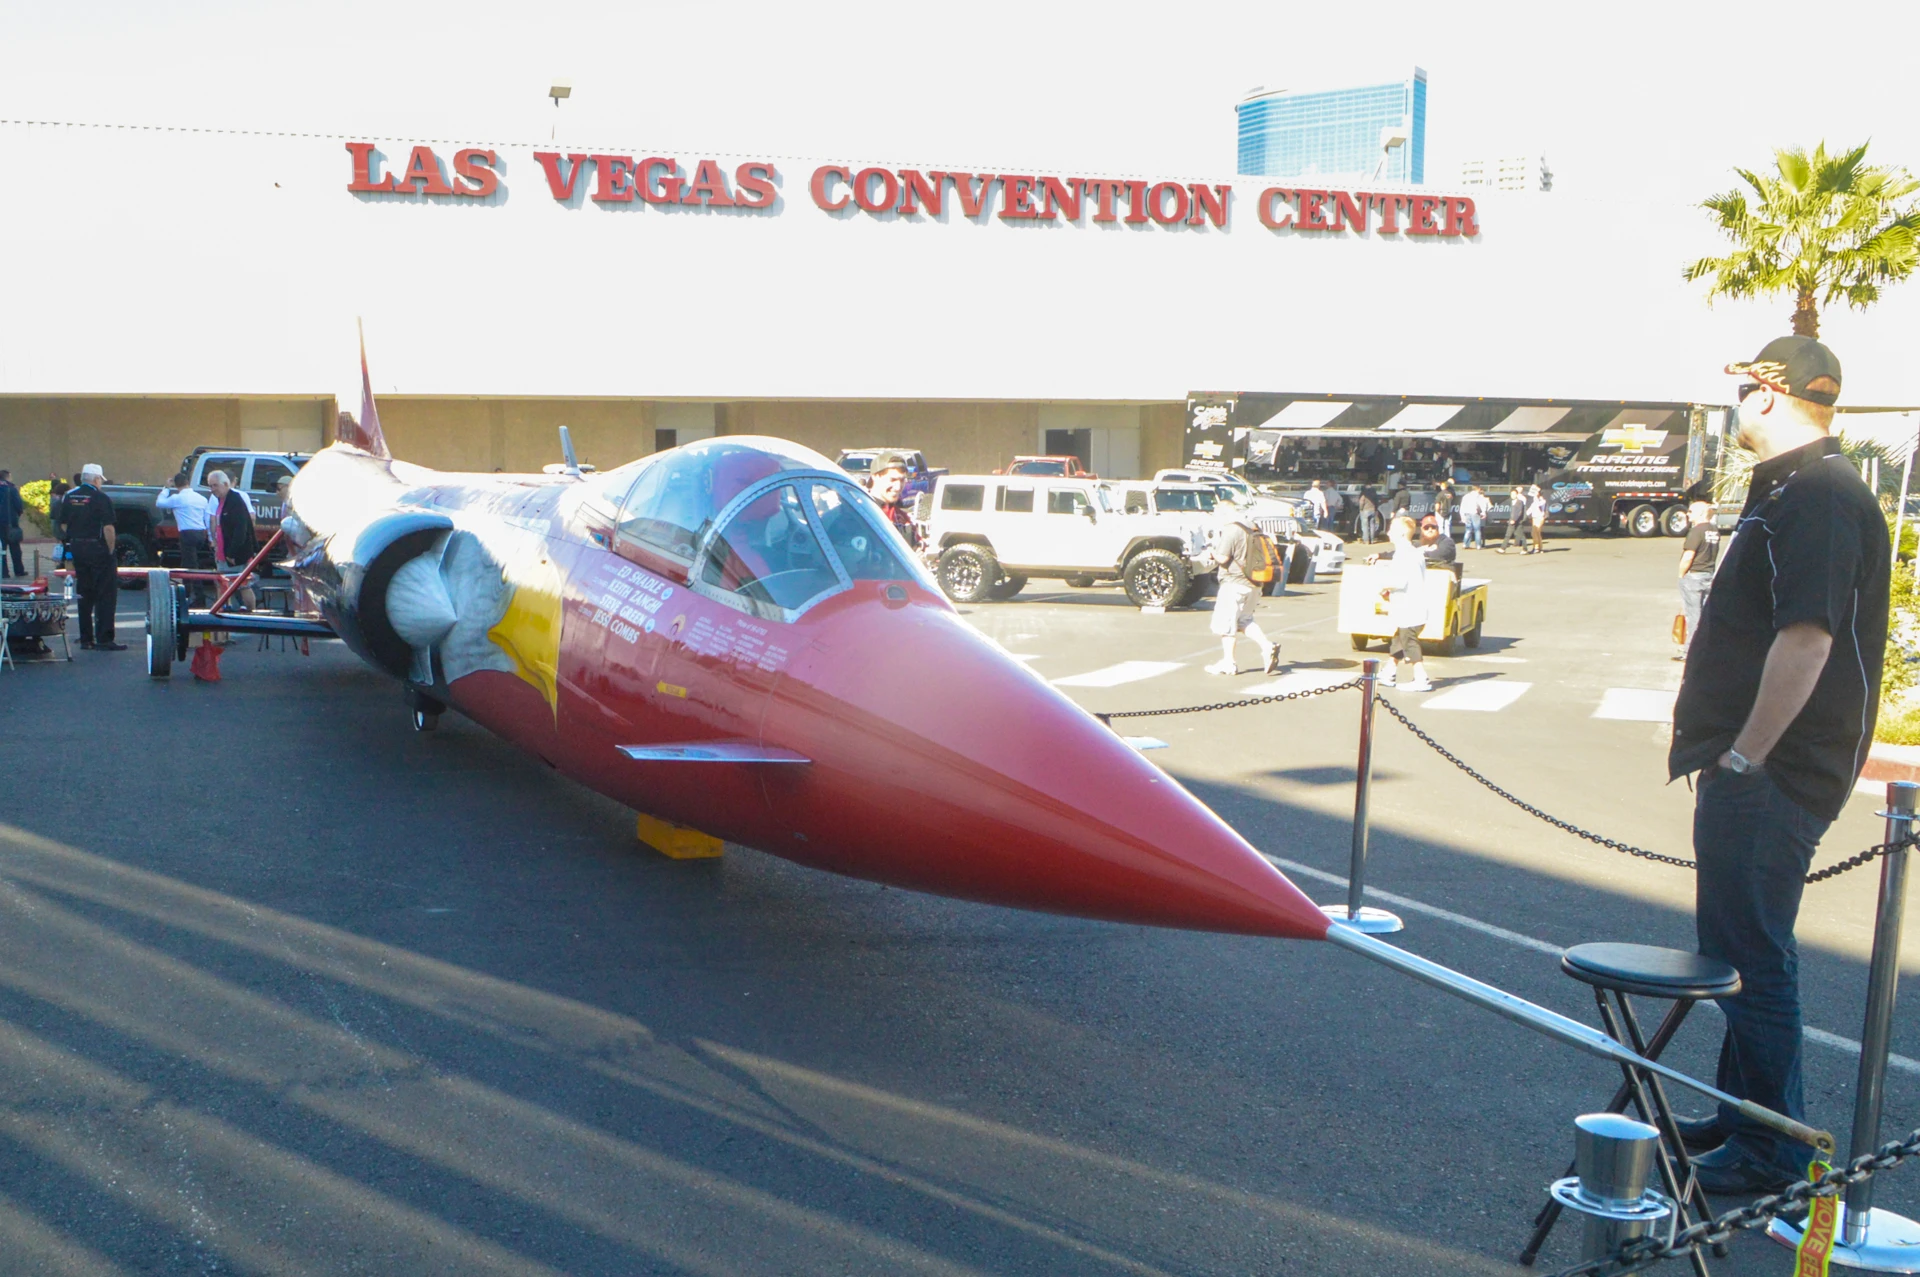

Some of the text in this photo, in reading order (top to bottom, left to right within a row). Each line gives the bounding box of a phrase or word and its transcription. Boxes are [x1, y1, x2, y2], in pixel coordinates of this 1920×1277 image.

[346, 142, 1479, 237] LAS VEGAS CONVENTION CENTER
[1577, 465, 1680, 473] MERCHANDISE
[1590, 455, 1669, 465] RACING
[254, 505, 280, 519] UNT
[607, 578, 634, 598] KEITH
[628, 590, 664, 614] ZANGHI
[617, 565, 632, 578] ED
[628, 571, 665, 594] SHADLE
[591, 609, 613, 628] JESSI
[610, 619, 640, 644] COMBS
[600, 594, 622, 613] STEVE
[620, 605, 648, 627] GREEN
[1807, 1196, 1833, 1253] MOVE
